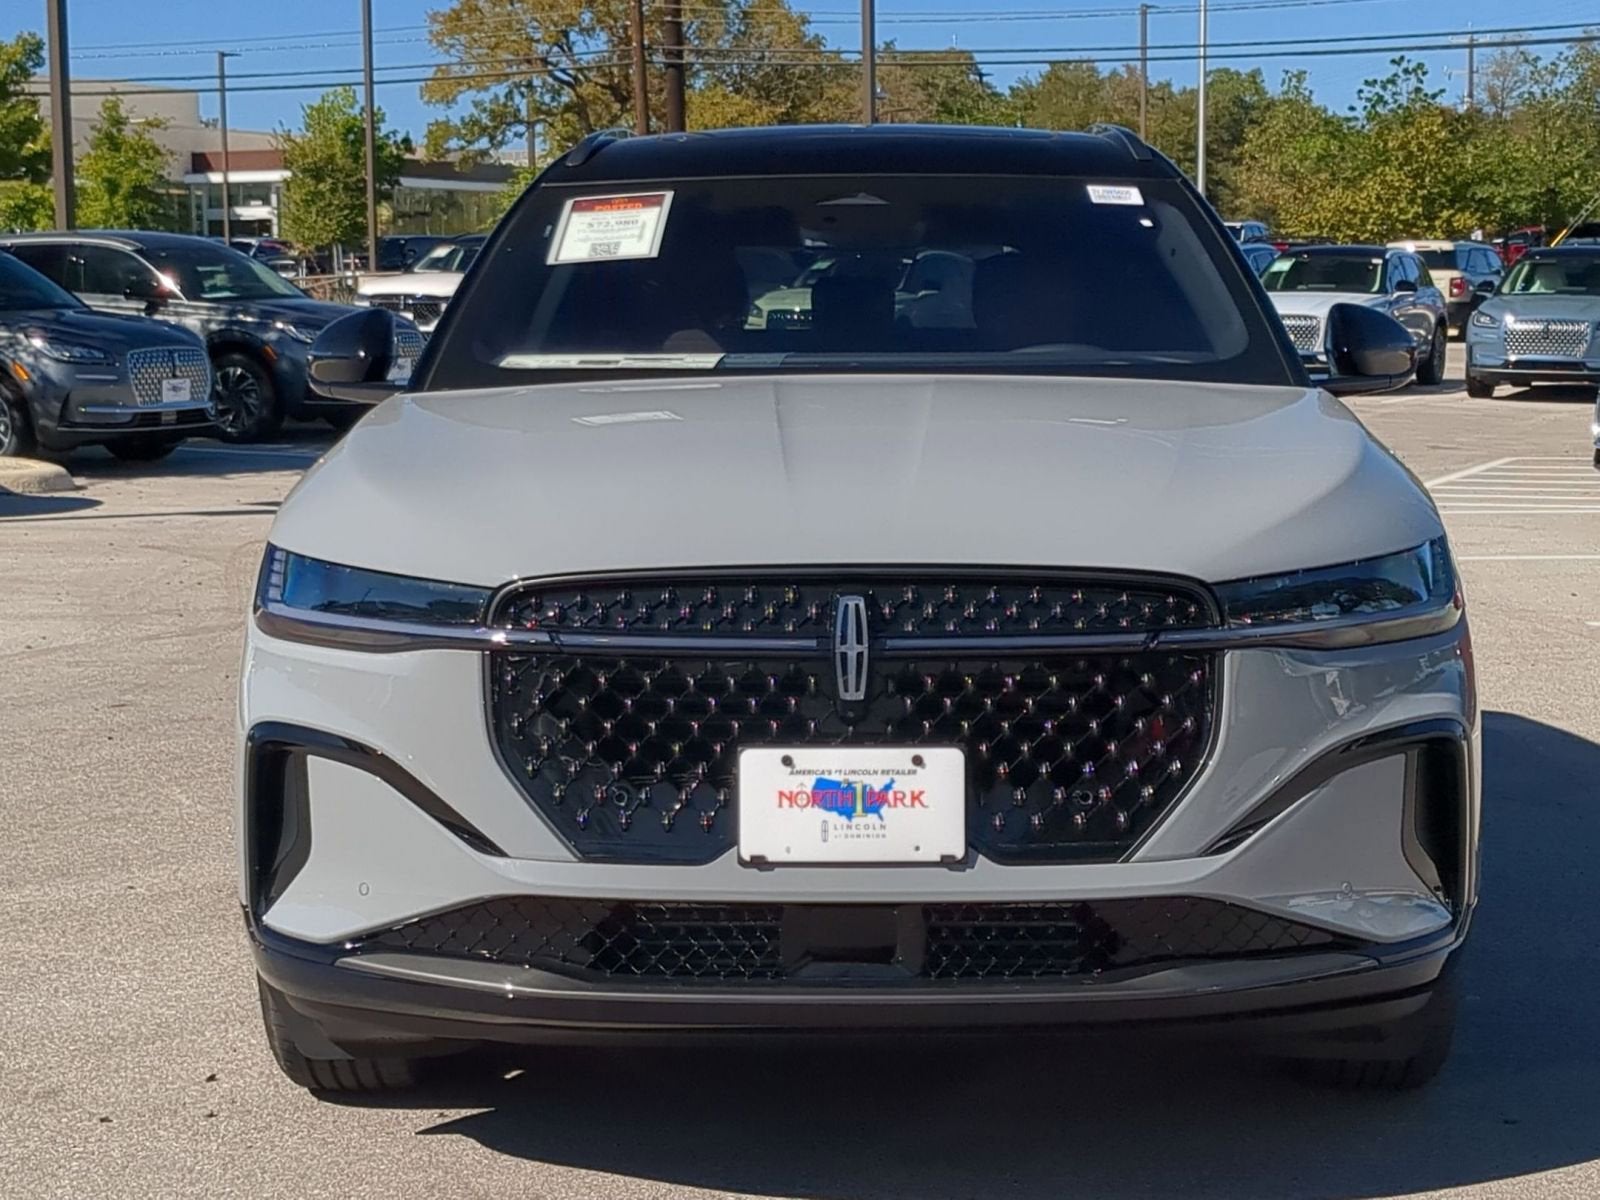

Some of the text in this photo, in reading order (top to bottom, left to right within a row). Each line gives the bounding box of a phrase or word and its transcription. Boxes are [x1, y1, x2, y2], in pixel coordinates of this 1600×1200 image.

[789, 768, 832, 776] AMERICA'S
[844, 768, 880, 776] LINCOLN
[881, 768, 917, 776] RETAILER
[777, 789, 854, 809] NORTH
[866, 789, 929, 809] PARK
[833, 823, 887, 831] LINCOLN
